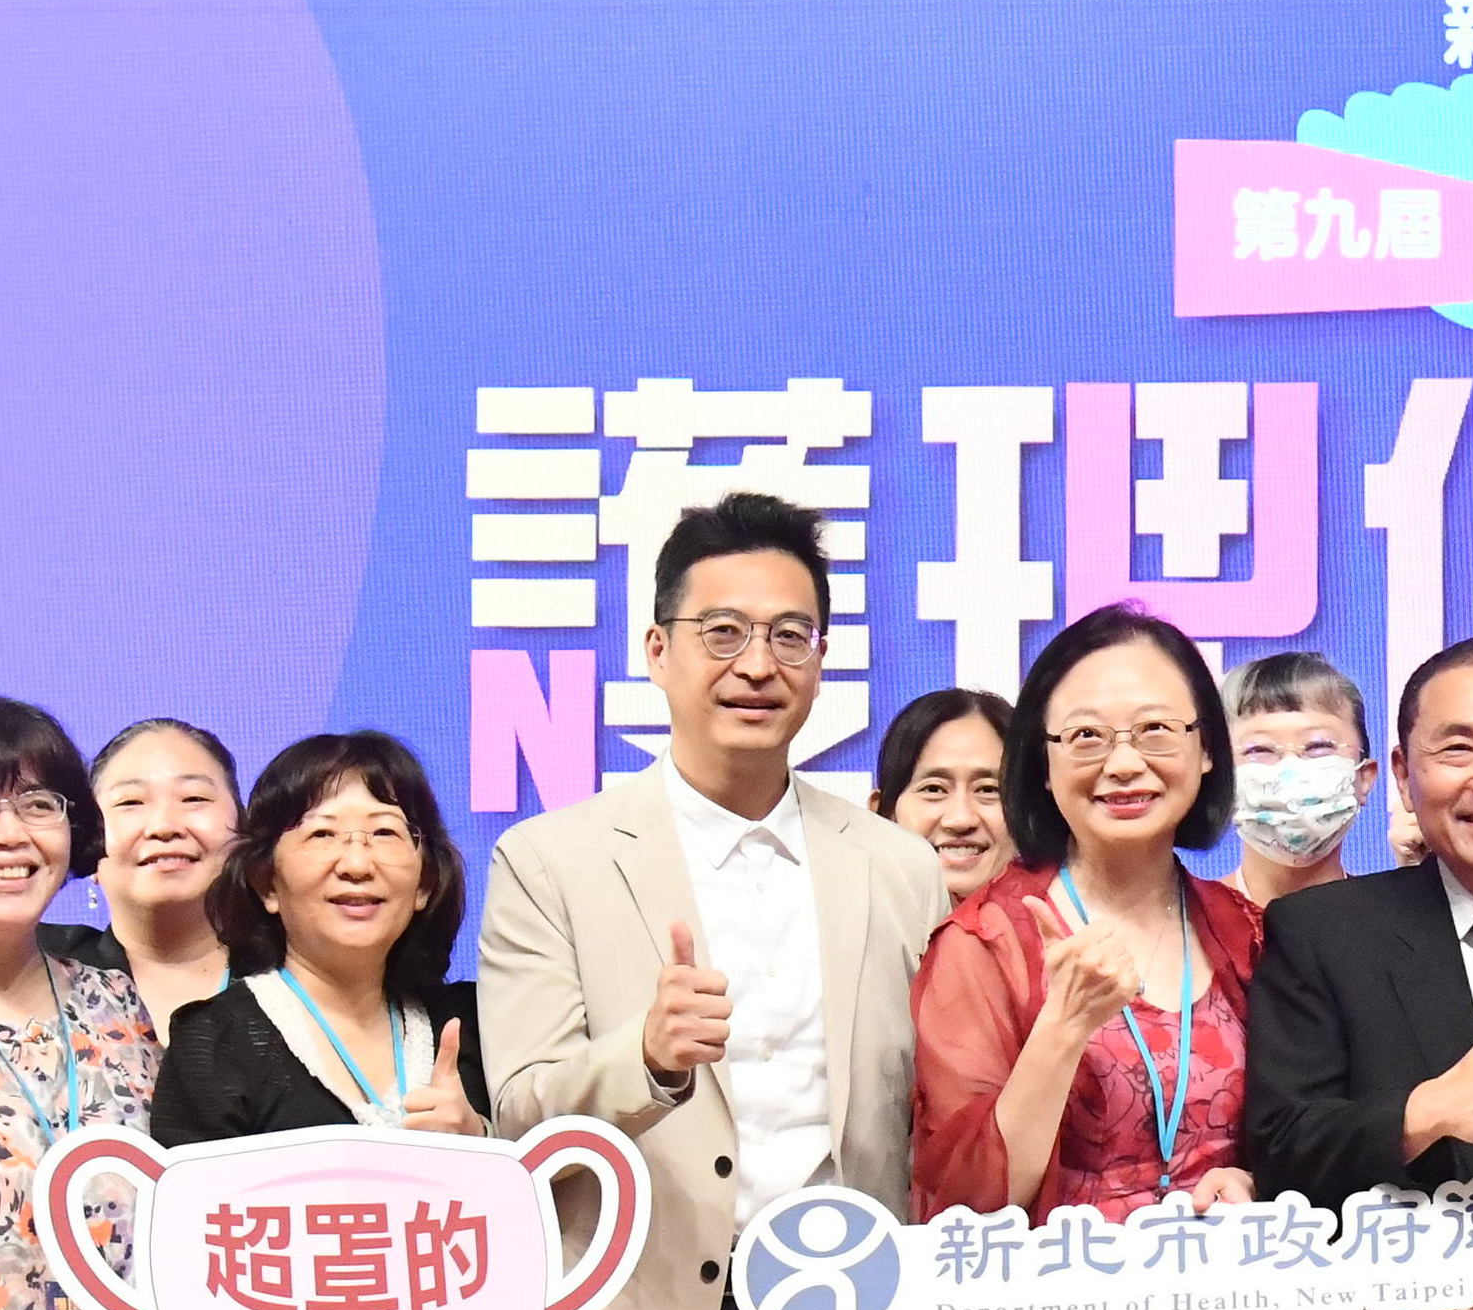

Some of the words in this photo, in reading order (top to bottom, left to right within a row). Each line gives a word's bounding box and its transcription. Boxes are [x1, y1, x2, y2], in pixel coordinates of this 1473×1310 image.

[1232, 186, 1443, 260] 第九屆
[1296, 1287, 1357, 1306] New
[1372, 1279, 1465, 1304] Taipei
